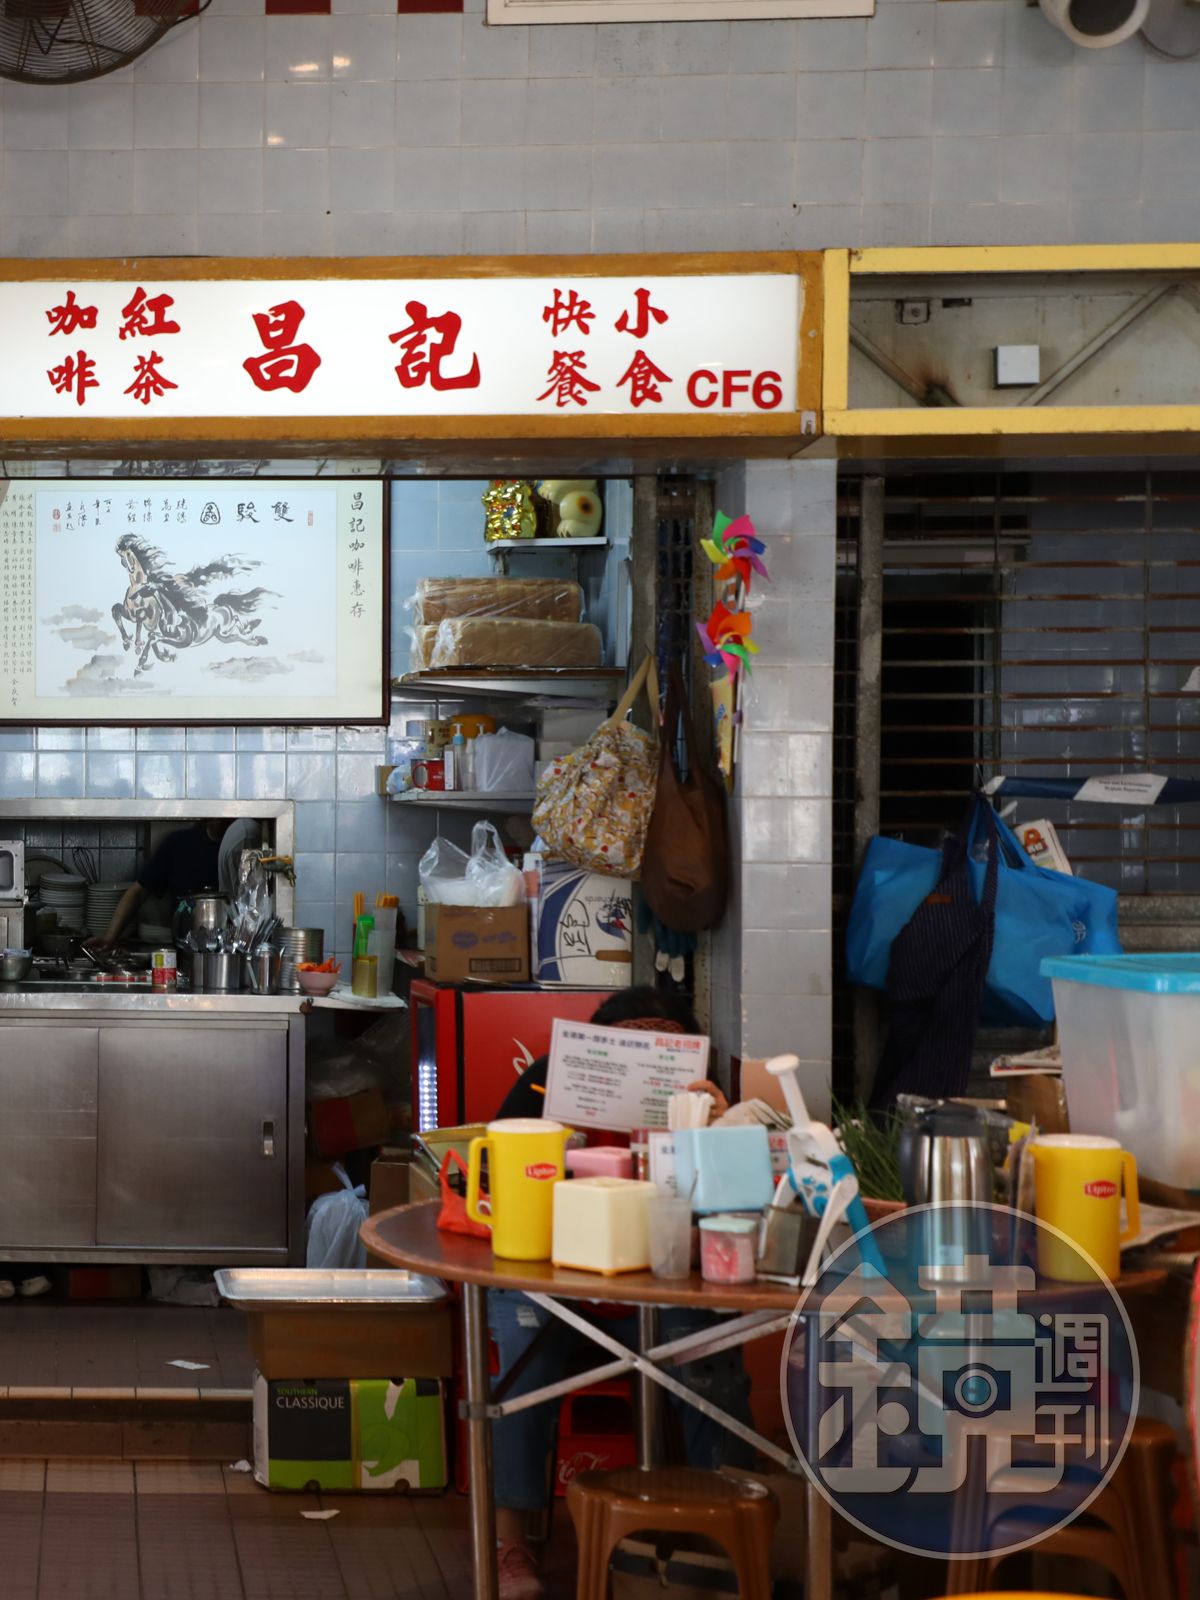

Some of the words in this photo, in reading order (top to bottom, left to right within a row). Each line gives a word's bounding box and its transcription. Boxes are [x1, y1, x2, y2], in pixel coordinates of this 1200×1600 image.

[46, 290, 100, 406] 咖啡
[118, 286, 181, 405] 紅茶
[241, 300, 482, 393] 昌記
[537, 287, 601, 408] 快餐
[615, 287, 674, 406] 小食
[685, 368, 784, 411] CF6
[348, 491, 366, 619] 昌記咖啡惠存
[526, 1163, 557, 1180] Lipton
[1085, 1181, 1117, 1198] Lipton
[276, 1388, 318, 1396] SOUTHERN
[276, 1396, 344, 1409] CLASSIQUE
